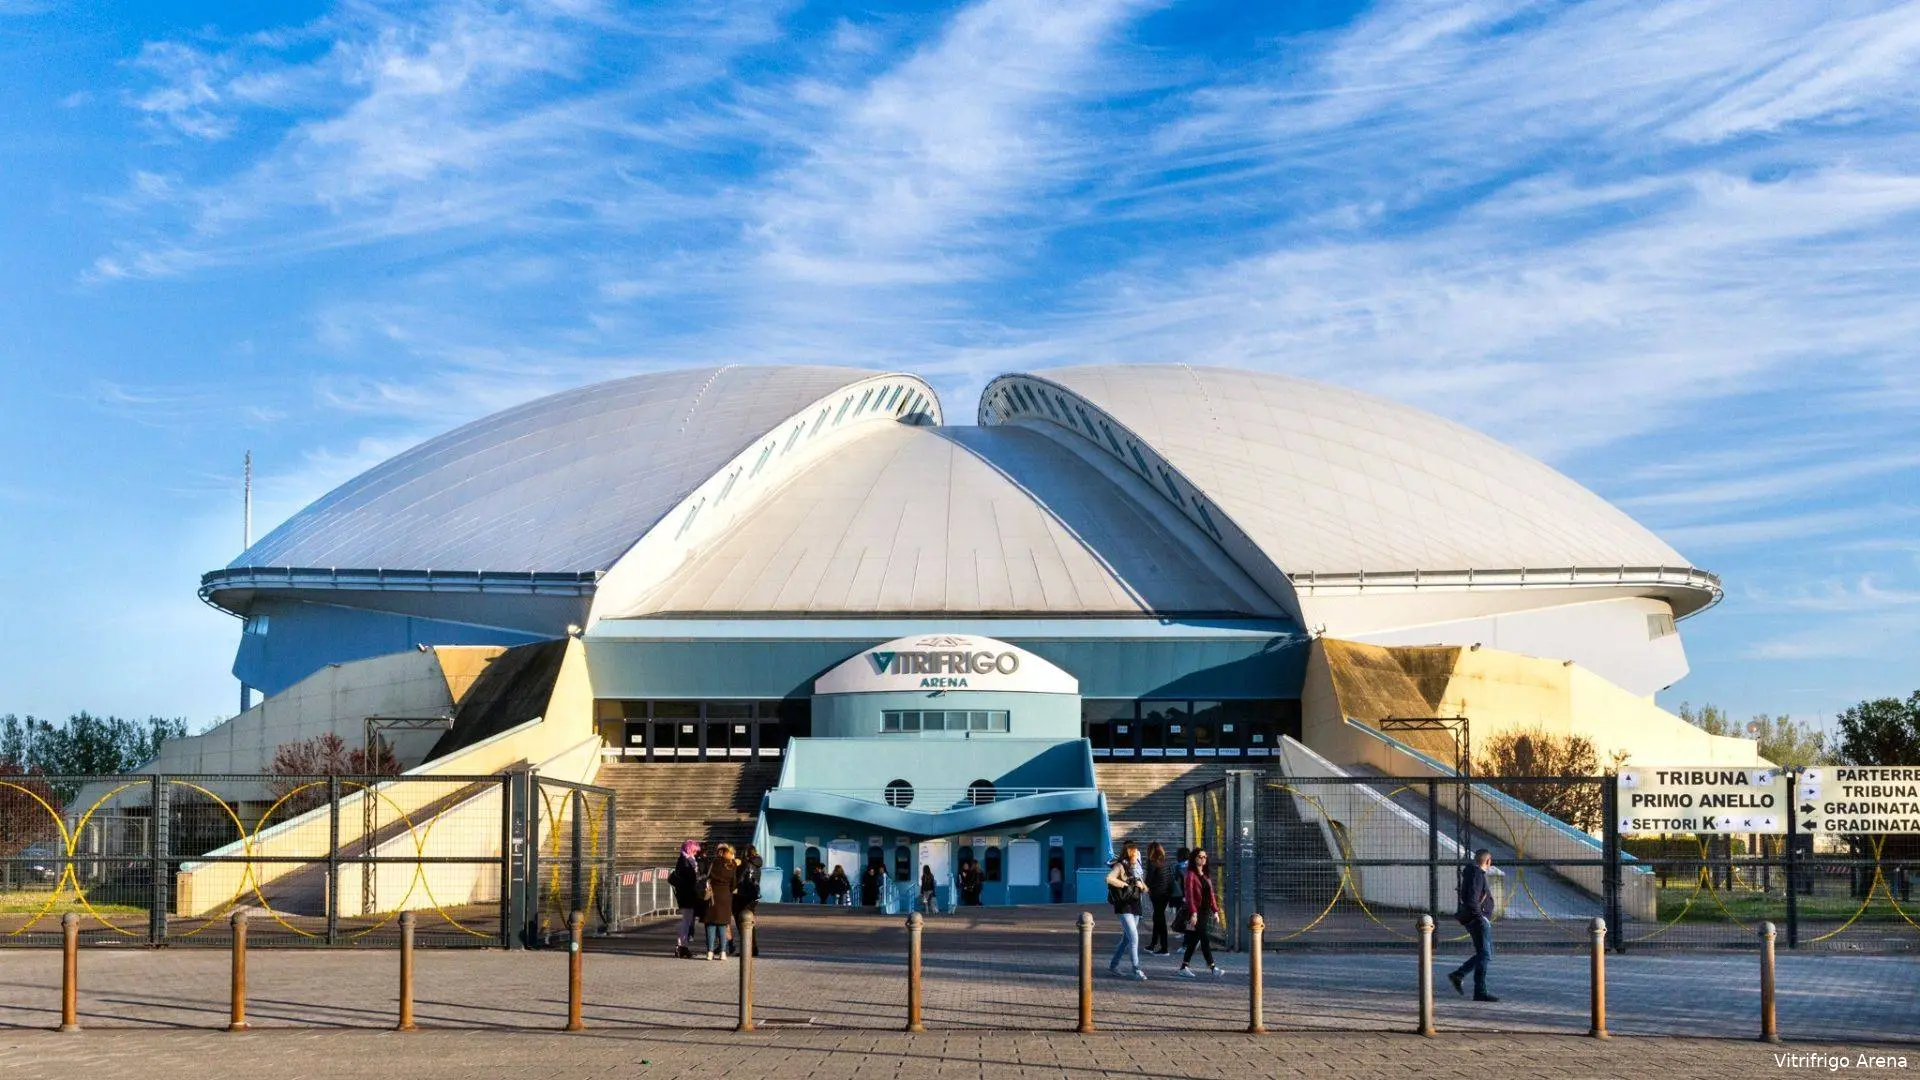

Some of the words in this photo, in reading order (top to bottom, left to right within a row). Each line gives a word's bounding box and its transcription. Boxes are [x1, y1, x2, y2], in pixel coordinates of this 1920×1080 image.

[869, 651, 1020, 675] VITRIFRIGO
[919, 677, 968, 688] ARENA
[1656, 771, 1749, 785] TRIBUNA
[1836, 769, 1920, 781] PARTERRE
[1842, 785, 1918, 797] TRIBUNA
[1631, 794, 1693, 808] PRIMO
[1699, 794, 1775, 808] ANELLO
[1823, 802, 1920, 814] GRADINATA
[1632, 818, 1697, 830] SETTORI
[1702, 816, 1716, 830] K
[1824, 819, 1920, 831] GRADINATA
